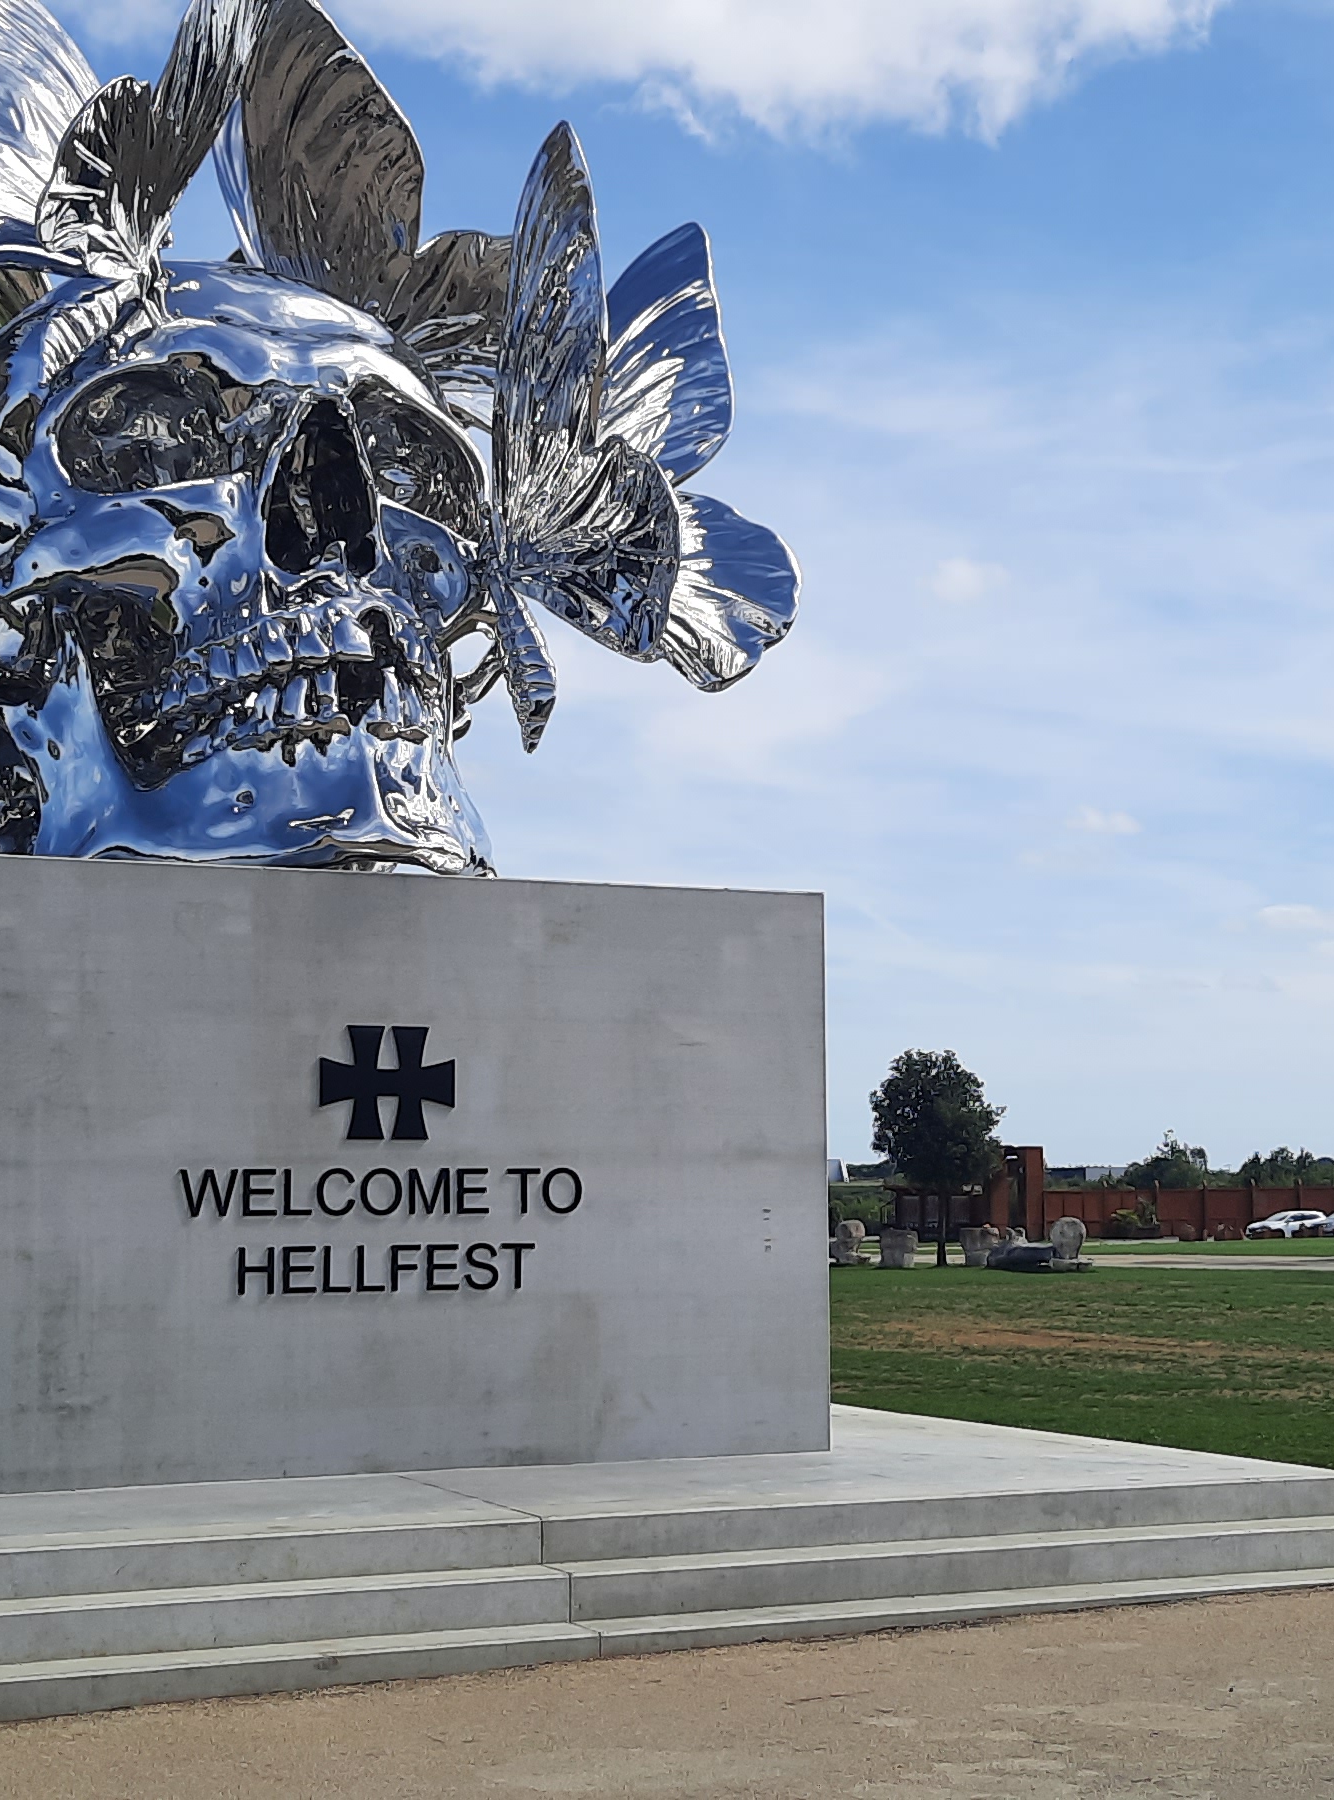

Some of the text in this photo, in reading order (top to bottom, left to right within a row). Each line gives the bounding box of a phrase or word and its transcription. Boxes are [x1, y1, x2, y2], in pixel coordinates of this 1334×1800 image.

[179, 1167, 583, 1218] WELCOME TO
[236, 1242, 535, 1296] HELLFEST
